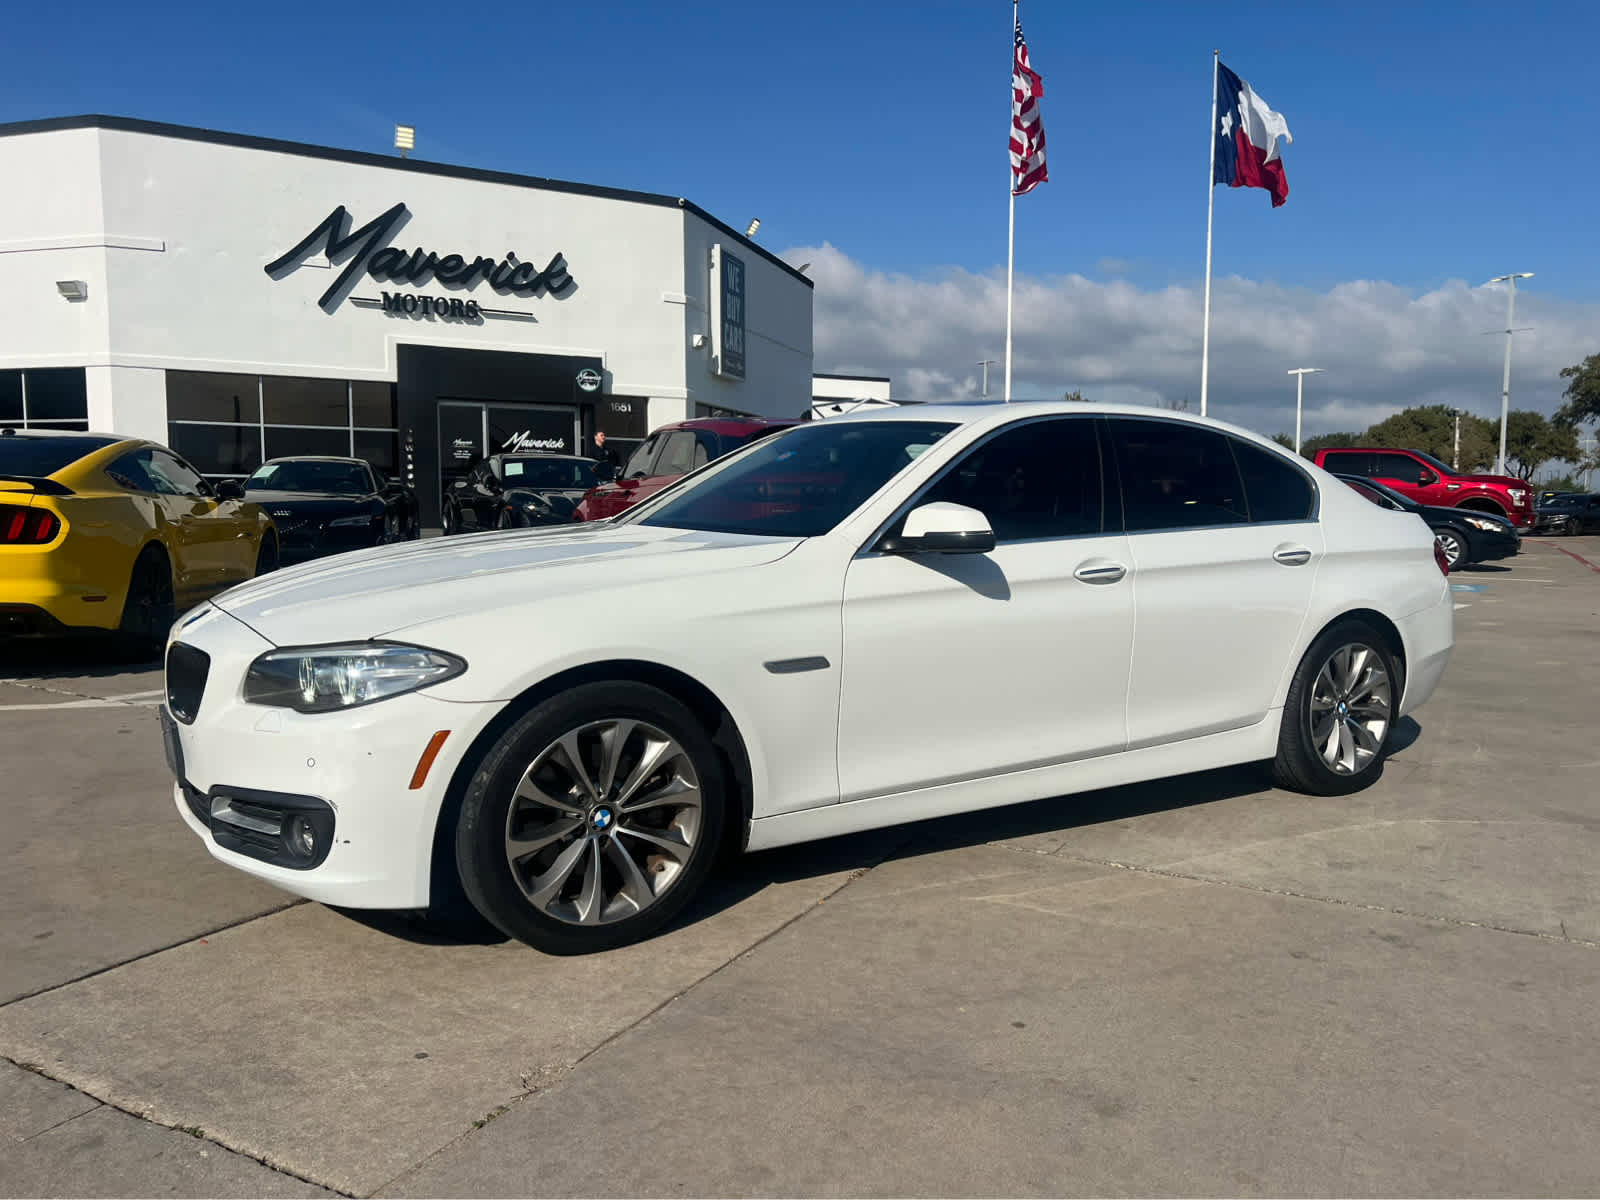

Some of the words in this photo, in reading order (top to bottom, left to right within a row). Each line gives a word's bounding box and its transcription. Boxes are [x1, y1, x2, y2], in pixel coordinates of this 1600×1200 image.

[264, 202, 574, 312] Maverick
[727, 260, 740, 293] WE
[380, 291, 480, 319] MOTORS
[501, 430, 565, 453] Maverick
